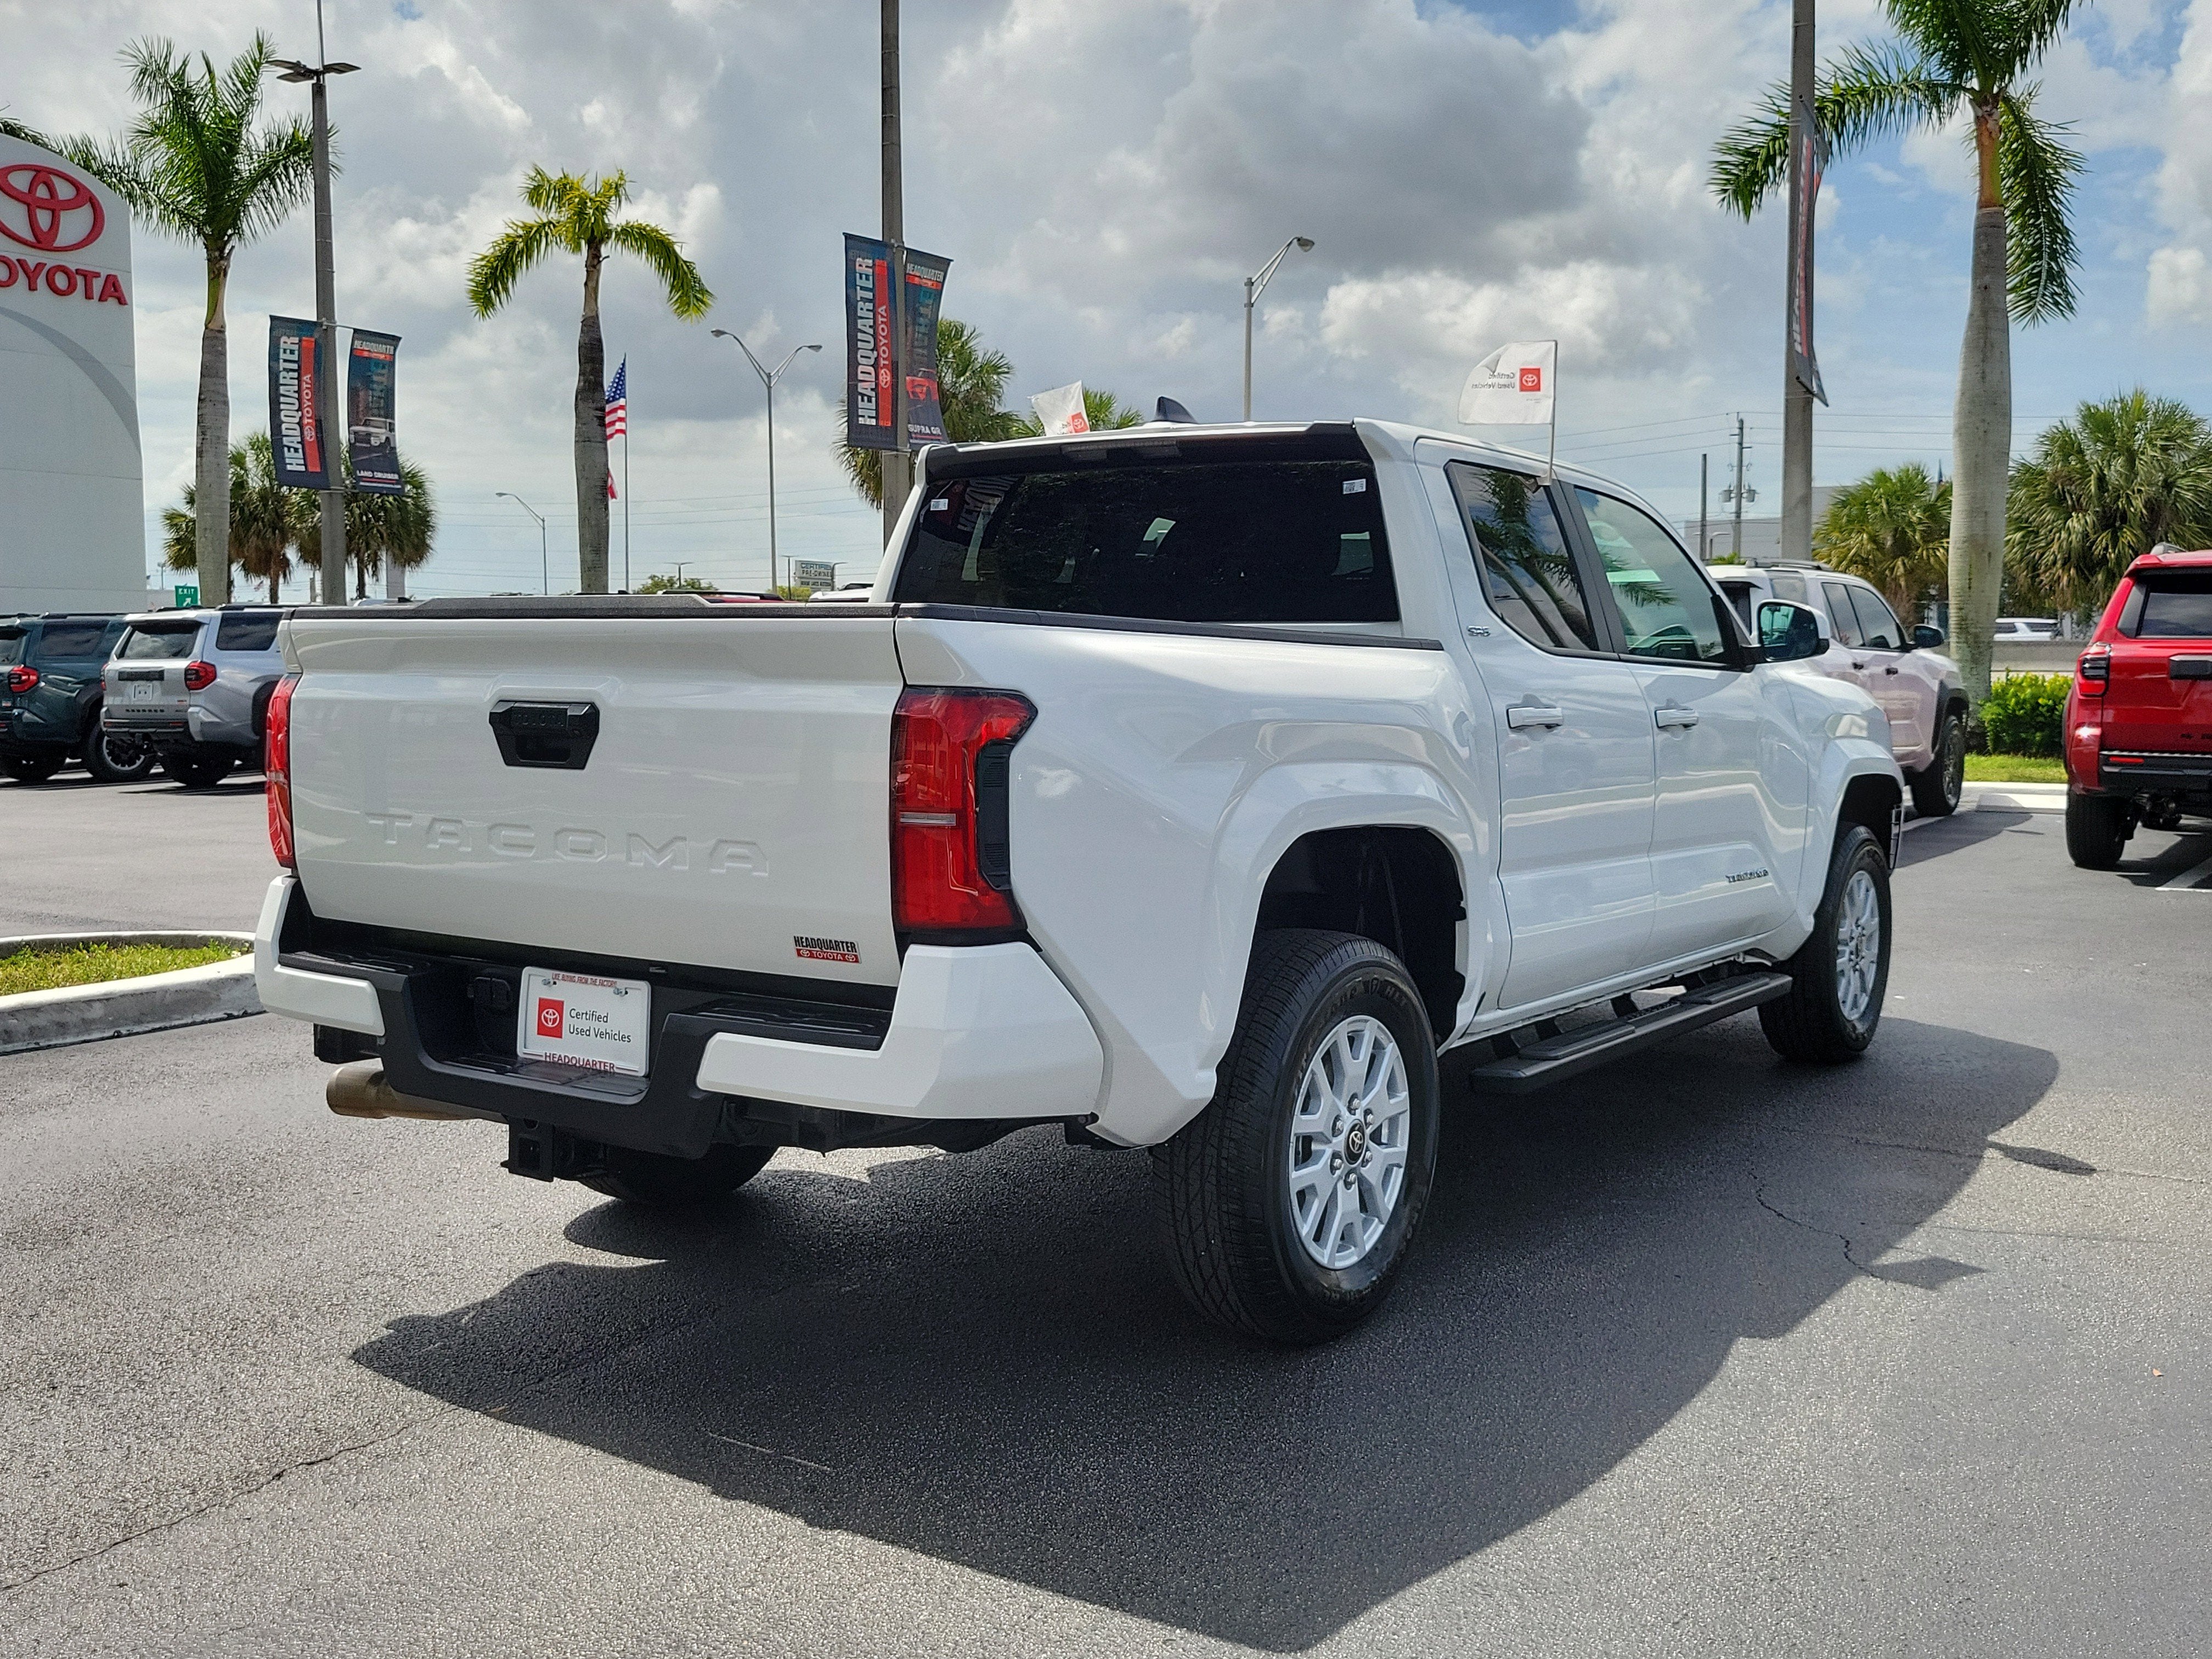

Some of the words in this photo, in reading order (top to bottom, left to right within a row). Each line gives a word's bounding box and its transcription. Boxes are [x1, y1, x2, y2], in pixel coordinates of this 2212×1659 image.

[906, 263, 944, 283] HEADQUARTER
[855, 257, 877, 426] HEADQUARTER
[877, 305, 890, 367] TOYOTA
[279, 335, 306, 472] HEADQUARTER
[303, 374, 315, 424] TOYOTA
[908, 424, 931, 434] SUPRA
[356, 470, 373, 478] LAND
[802, 569, 833, 578] PRE-OWNE
[365, 811, 769, 877] TACOMA
[793, 935, 857, 953] HEADQUARTER
[812, 950, 843, 960] TOYOTA
[569, 1008, 608, 1023] Certified
[569, 1024, 591, 1037] Used
[593, 1027, 631, 1043] Vehicles
[544, 1052, 615, 1071] HEADQUARTER
